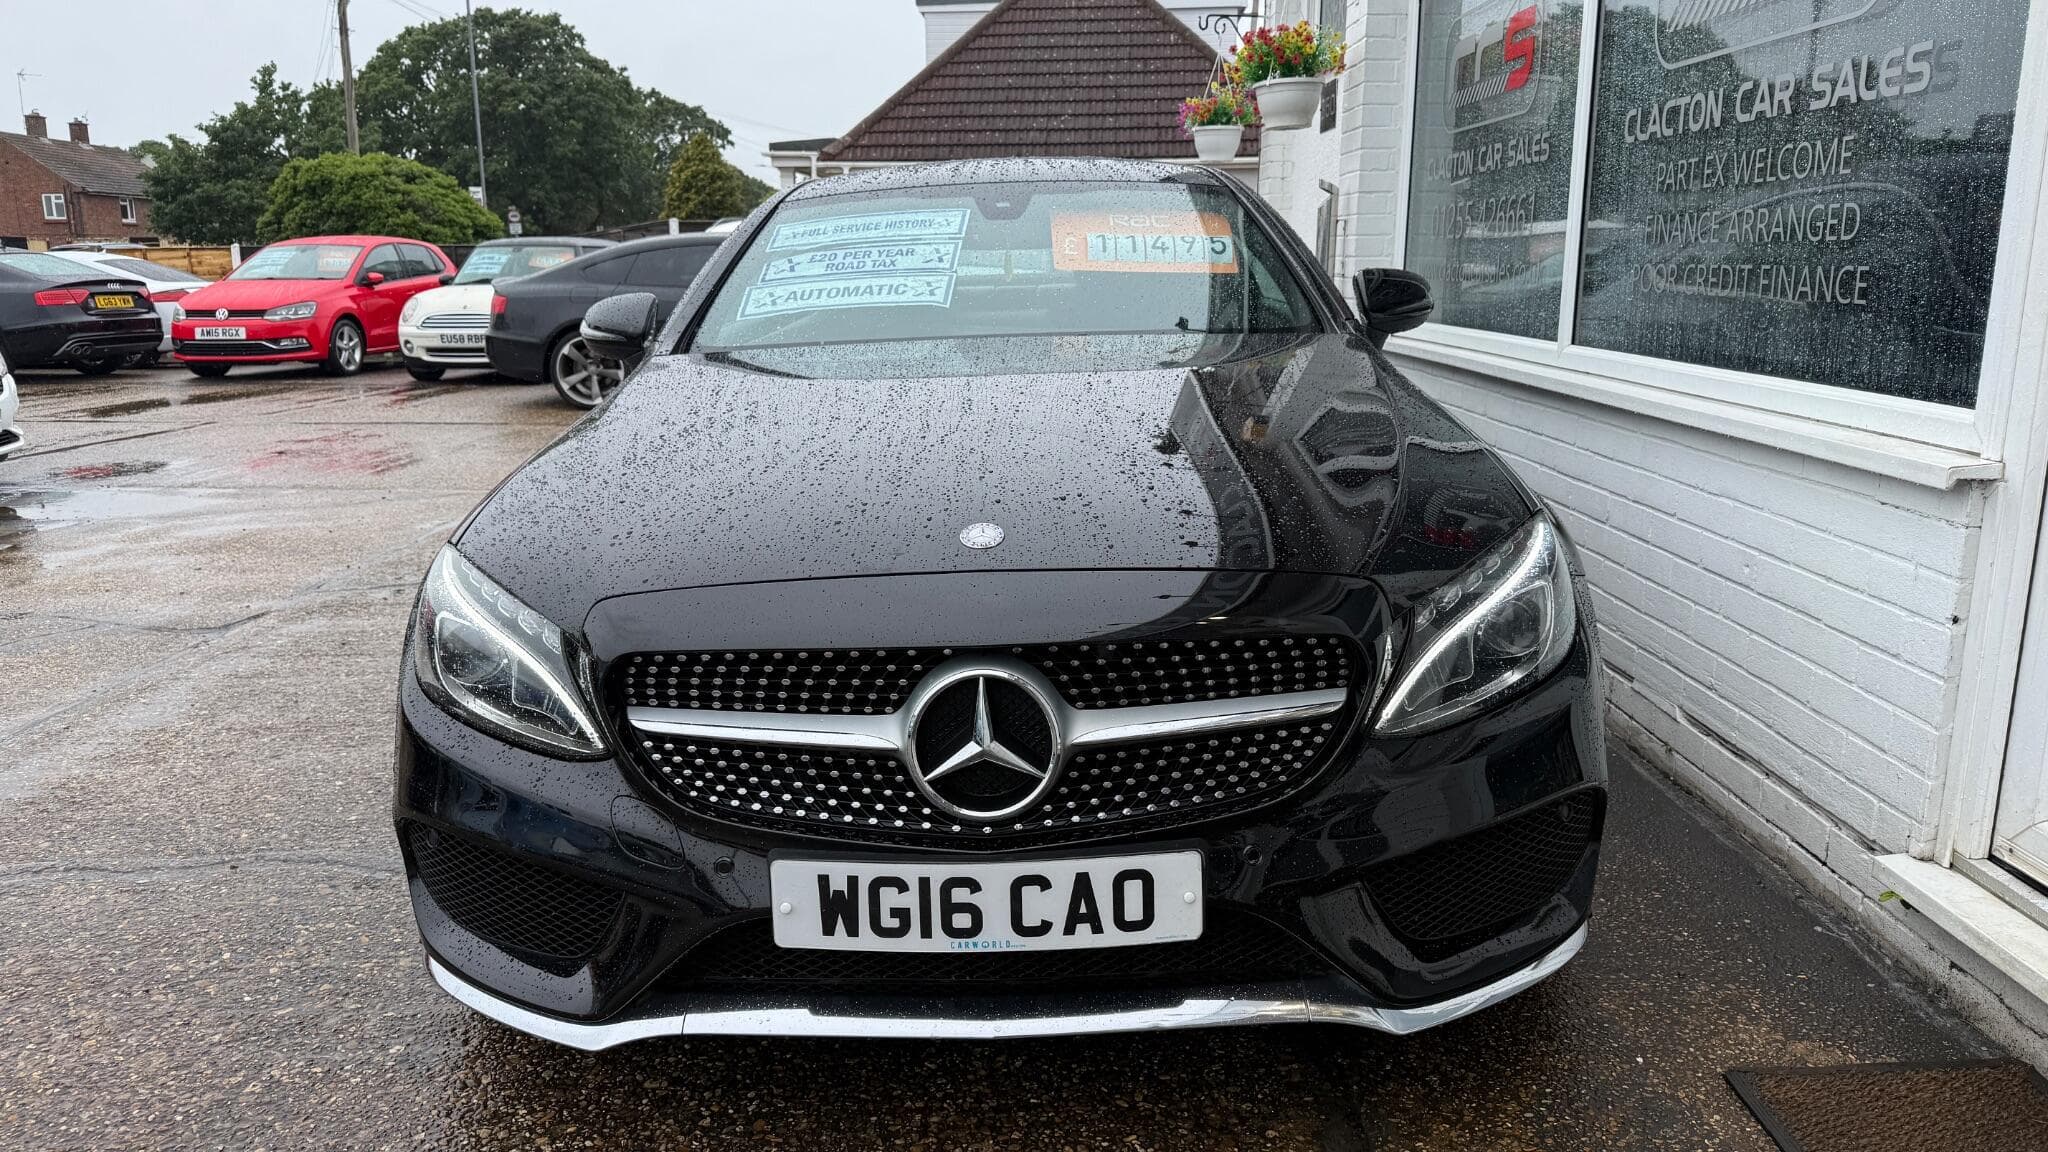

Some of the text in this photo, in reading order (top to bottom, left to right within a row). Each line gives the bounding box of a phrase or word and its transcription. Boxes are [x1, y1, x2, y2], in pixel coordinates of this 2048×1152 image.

[1624, 39, 1935, 144] CLACTON CAR SALES
[1427, 131, 1550, 181] CLACTON CAR SALES
[1655, 133, 1856, 192] PART EX WELCOME
[800, 218, 936, 238] FULL SERVICE HISTORY
[1644, 202, 1861, 245] FINANCE ARRANGED
[1095, 233, 1227, 255] 11495
[806, 247, 917, 264] £20 PER YEAR
[823, 259, 898, 272] ROAD TAX
[784, 283, 908, 302] AUTOMATIC
[1630, 262, 1870, 306] POOR CREDIT FINANCE
[200, 327, 241, 338] AW15 RGX
[439, 334, 465, 344] EU58
[816, 868, 1156, 940] WG16 CAO
[950, 939, 1011, 950] CARWORLD
